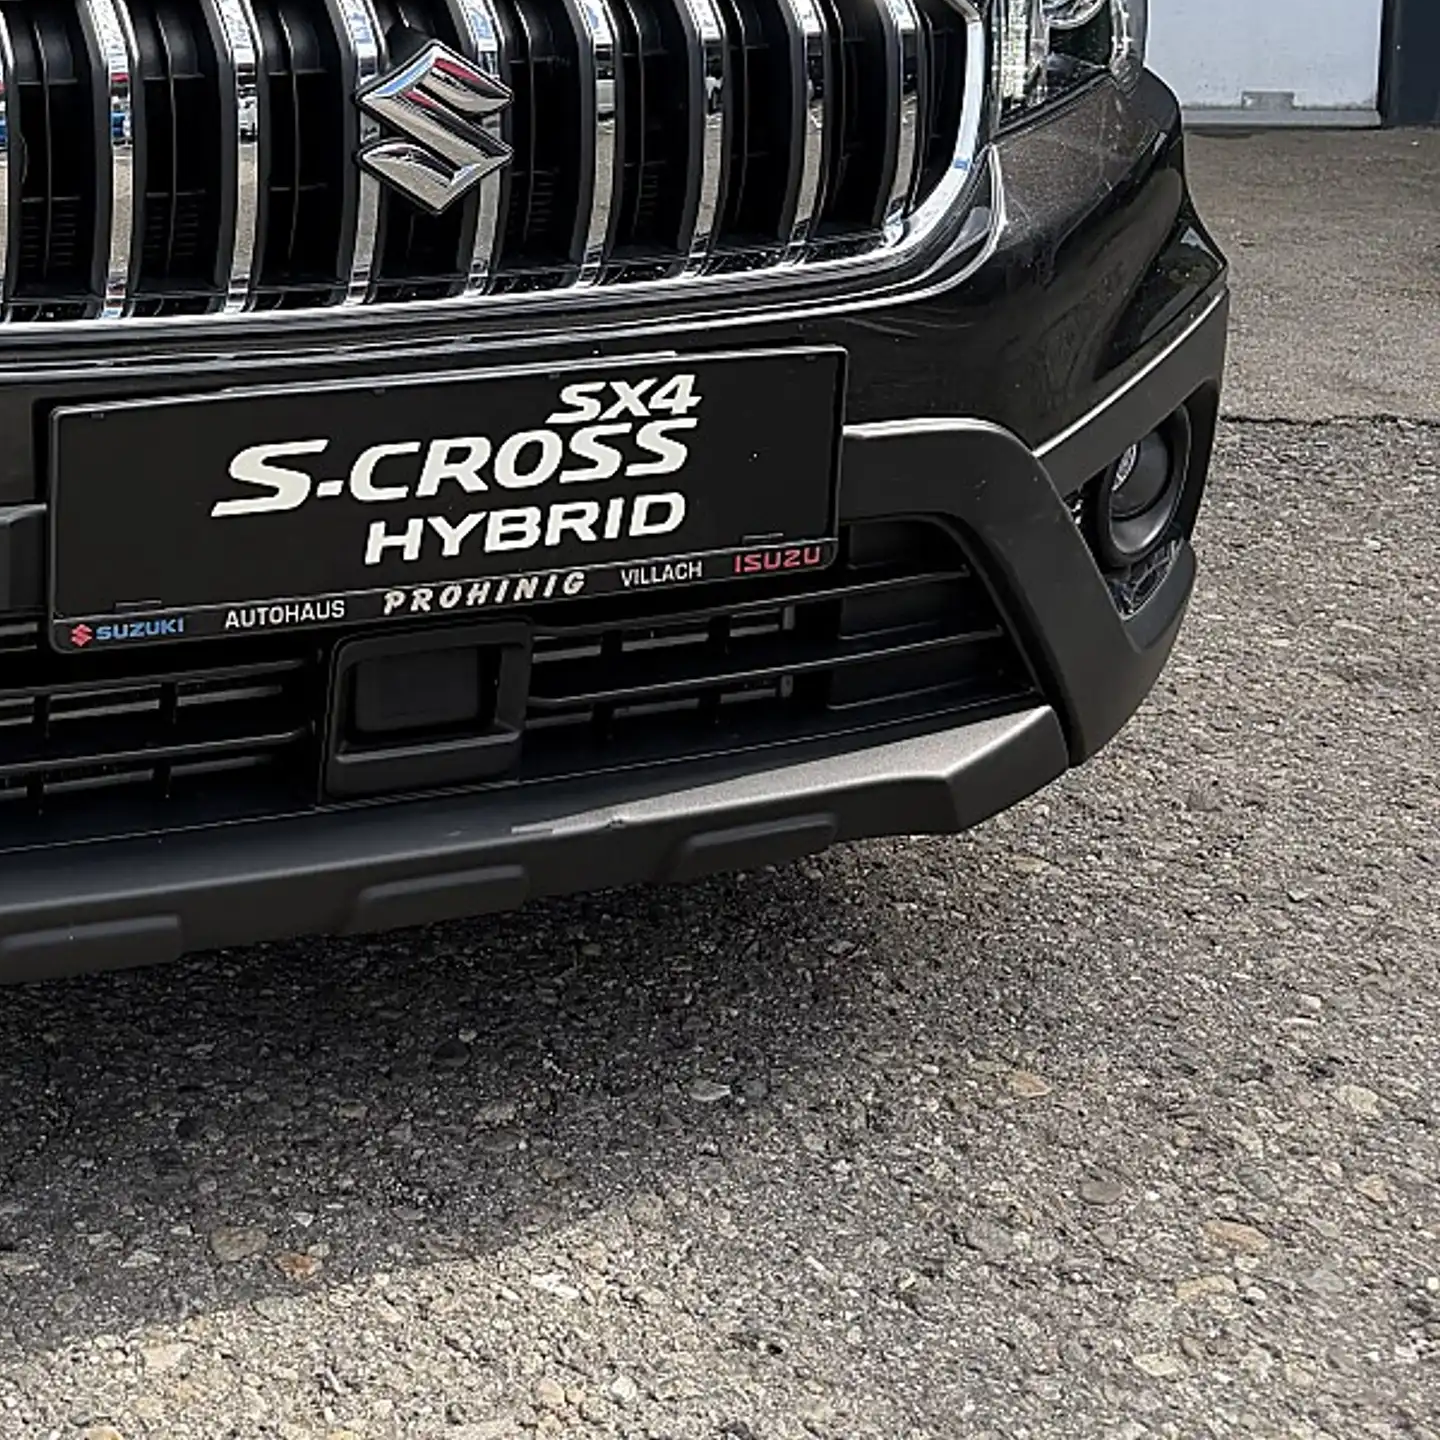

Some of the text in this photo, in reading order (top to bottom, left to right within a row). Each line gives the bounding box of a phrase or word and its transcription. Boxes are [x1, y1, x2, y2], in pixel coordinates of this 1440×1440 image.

[545, 374, 702, 424] SX4
[211, 417, 698, 517] S-CROSS
[364, 492, 686, 565] HYBRID
[96, 546, 821, 641] SUZUKI AUTOHAUS PROHINIG VILLACH ISUZU
